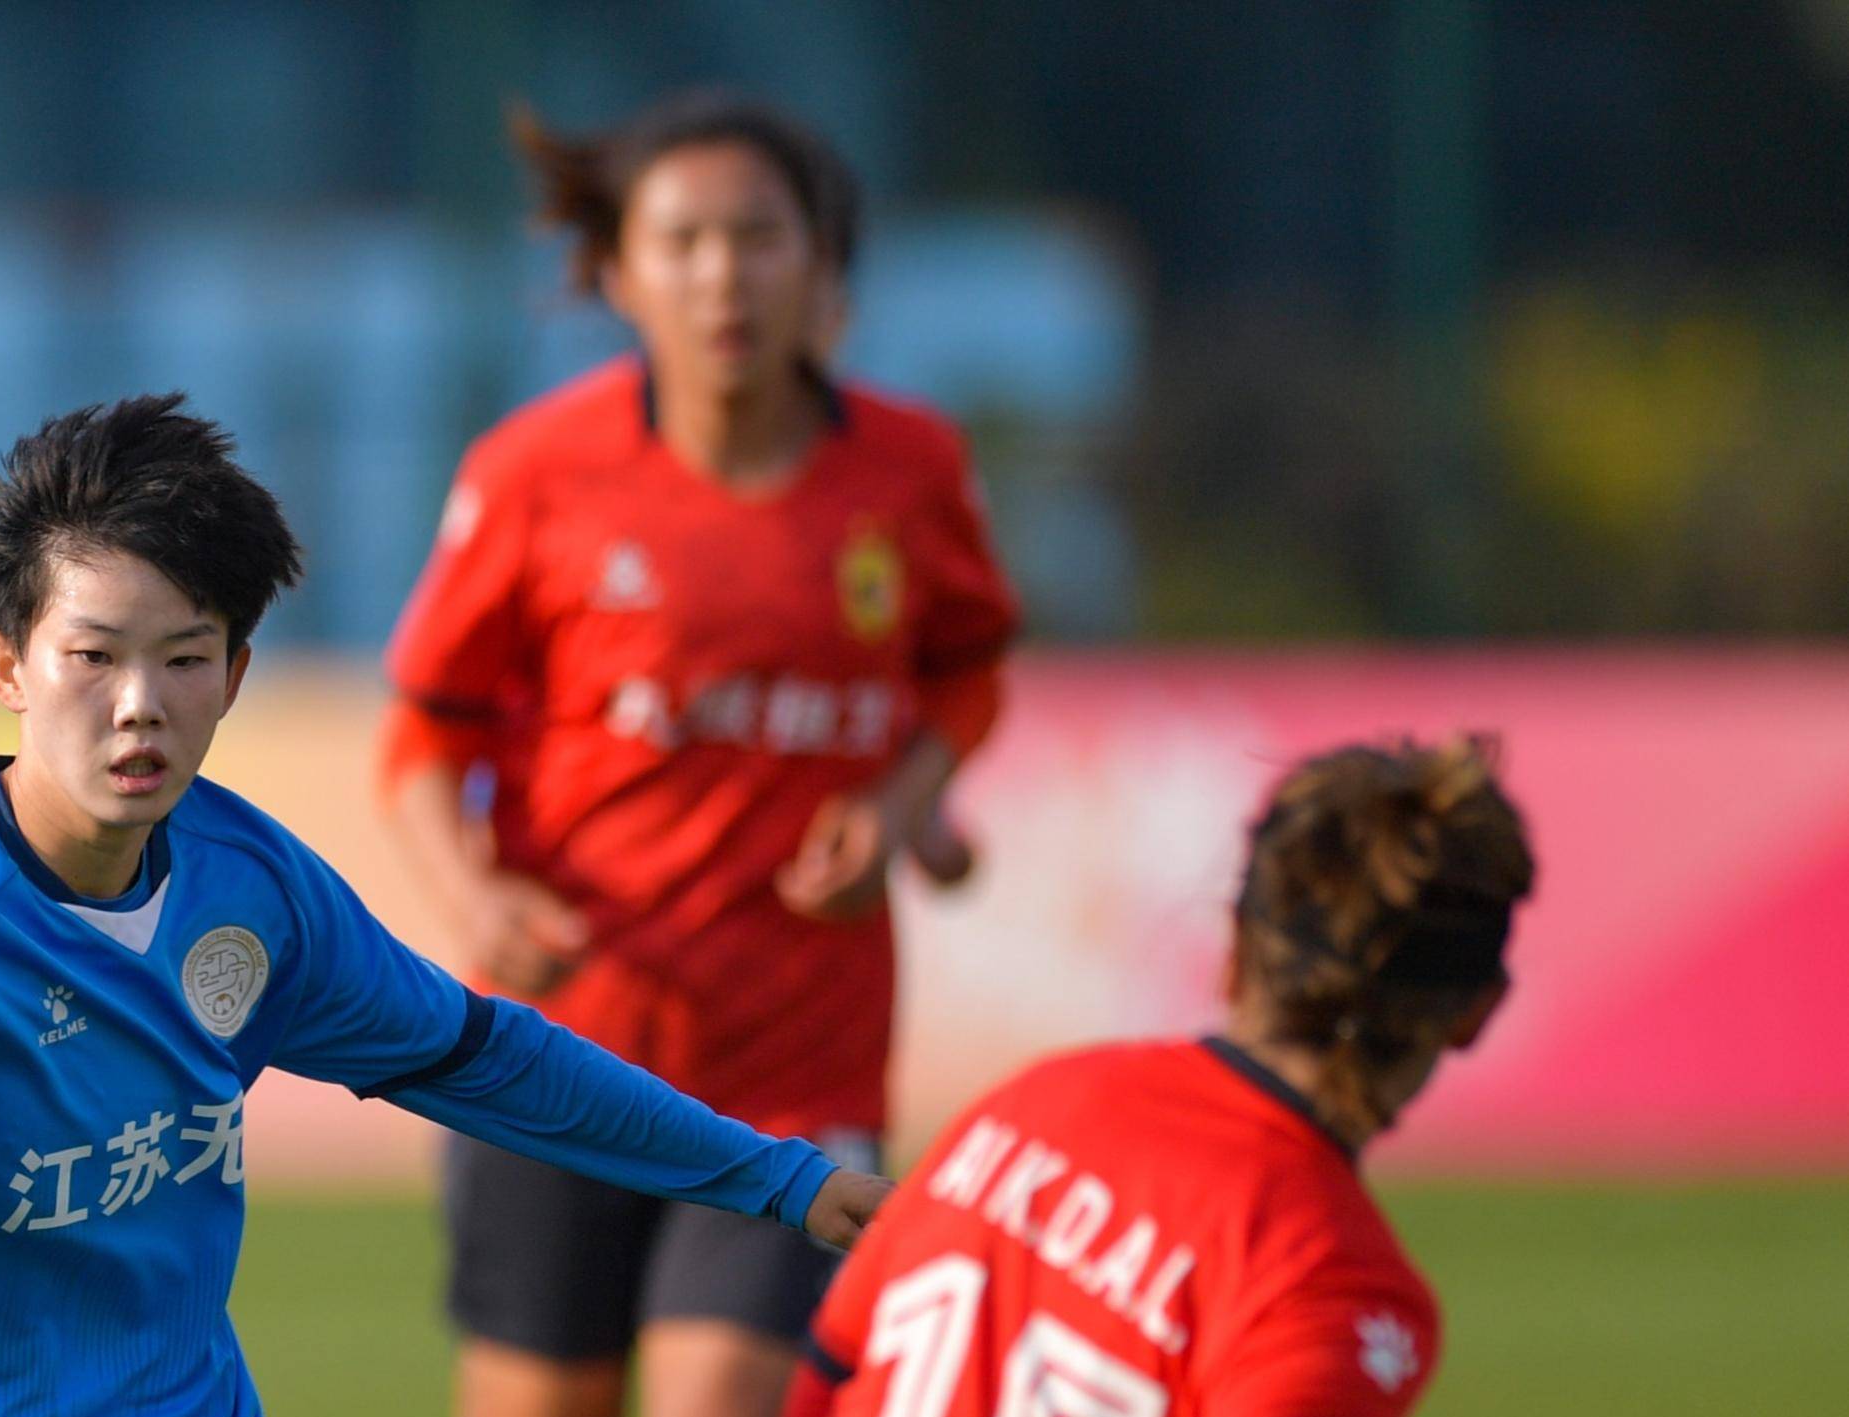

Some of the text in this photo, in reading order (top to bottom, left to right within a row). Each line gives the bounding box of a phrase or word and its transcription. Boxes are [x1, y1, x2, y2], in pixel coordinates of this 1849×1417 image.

[38, 1016, 88, 1049] KELME
[1, 1090, 244, 1233] 江苏无
